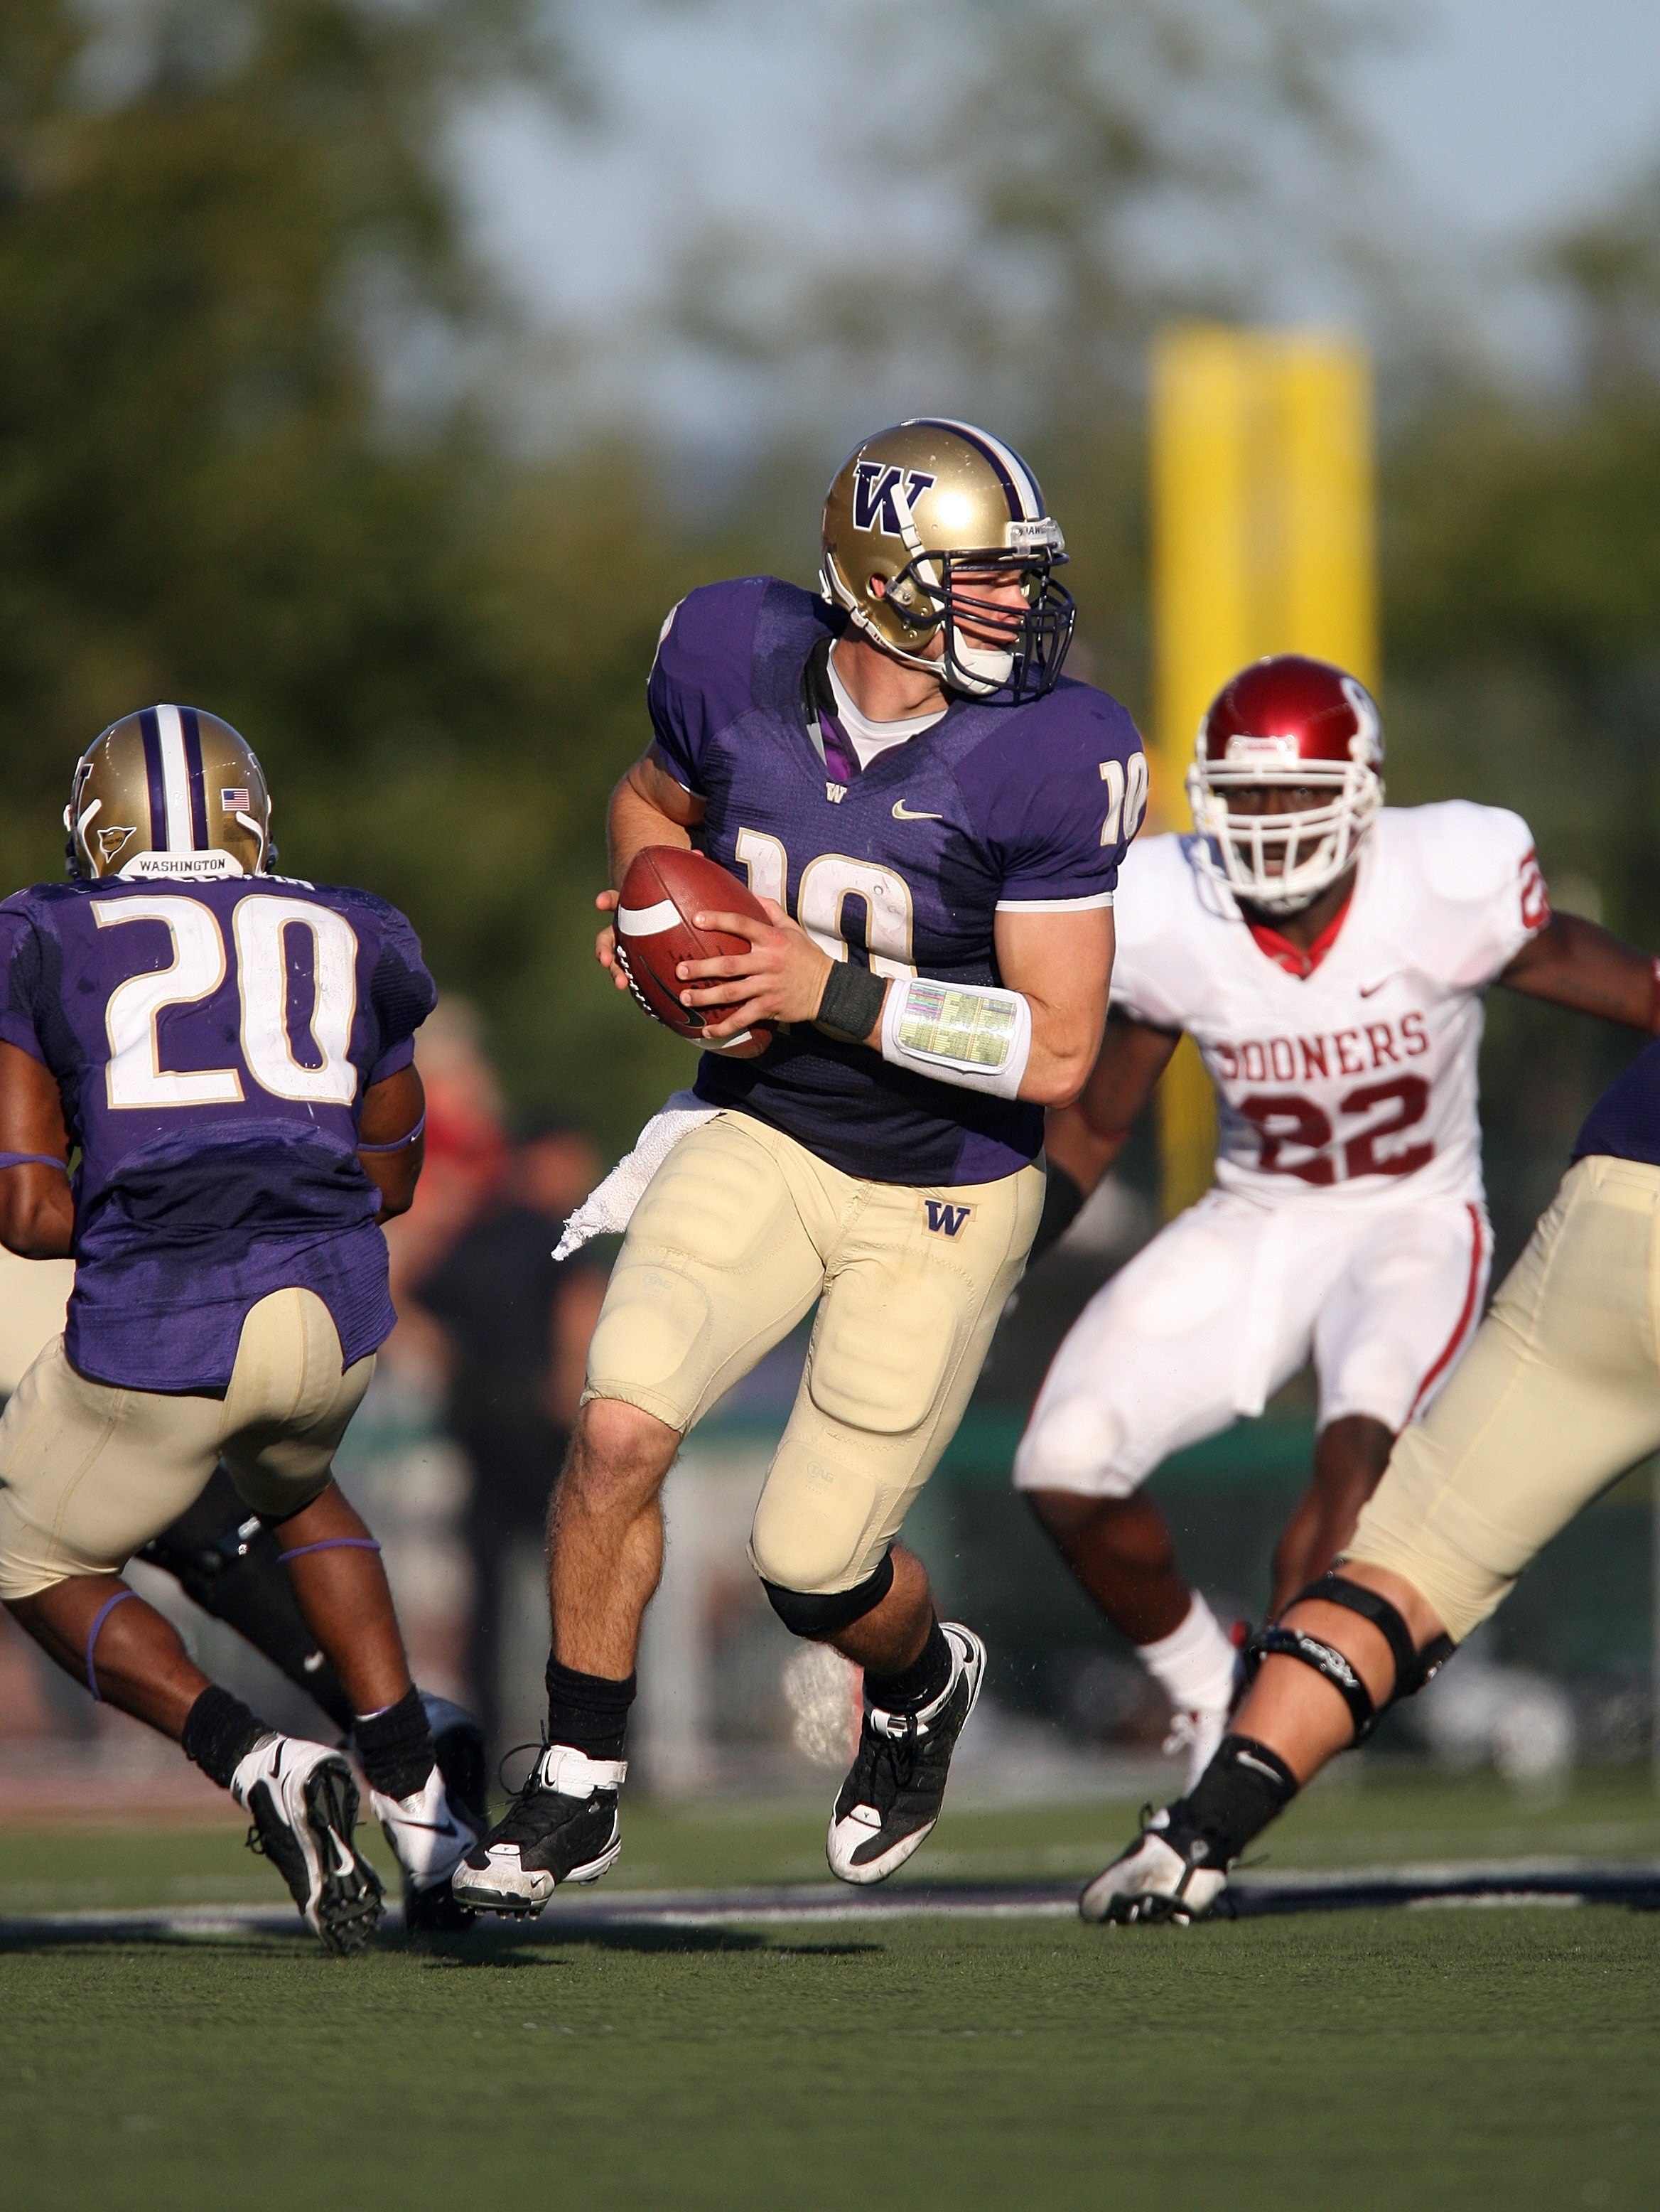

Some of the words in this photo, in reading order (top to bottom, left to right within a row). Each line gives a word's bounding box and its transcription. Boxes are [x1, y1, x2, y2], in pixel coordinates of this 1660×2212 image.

[852, 461, 938, 538] W
[826, 781, 848, 804] W
[1099, 751, 1148, 847] 10
[139, 858, 226, 872] WASHINGTON
[90, 894, 357, 1109] 20
[1216, 1012, 1429, 1081] SOONERS
[924, 1199, 971, 1237] W
